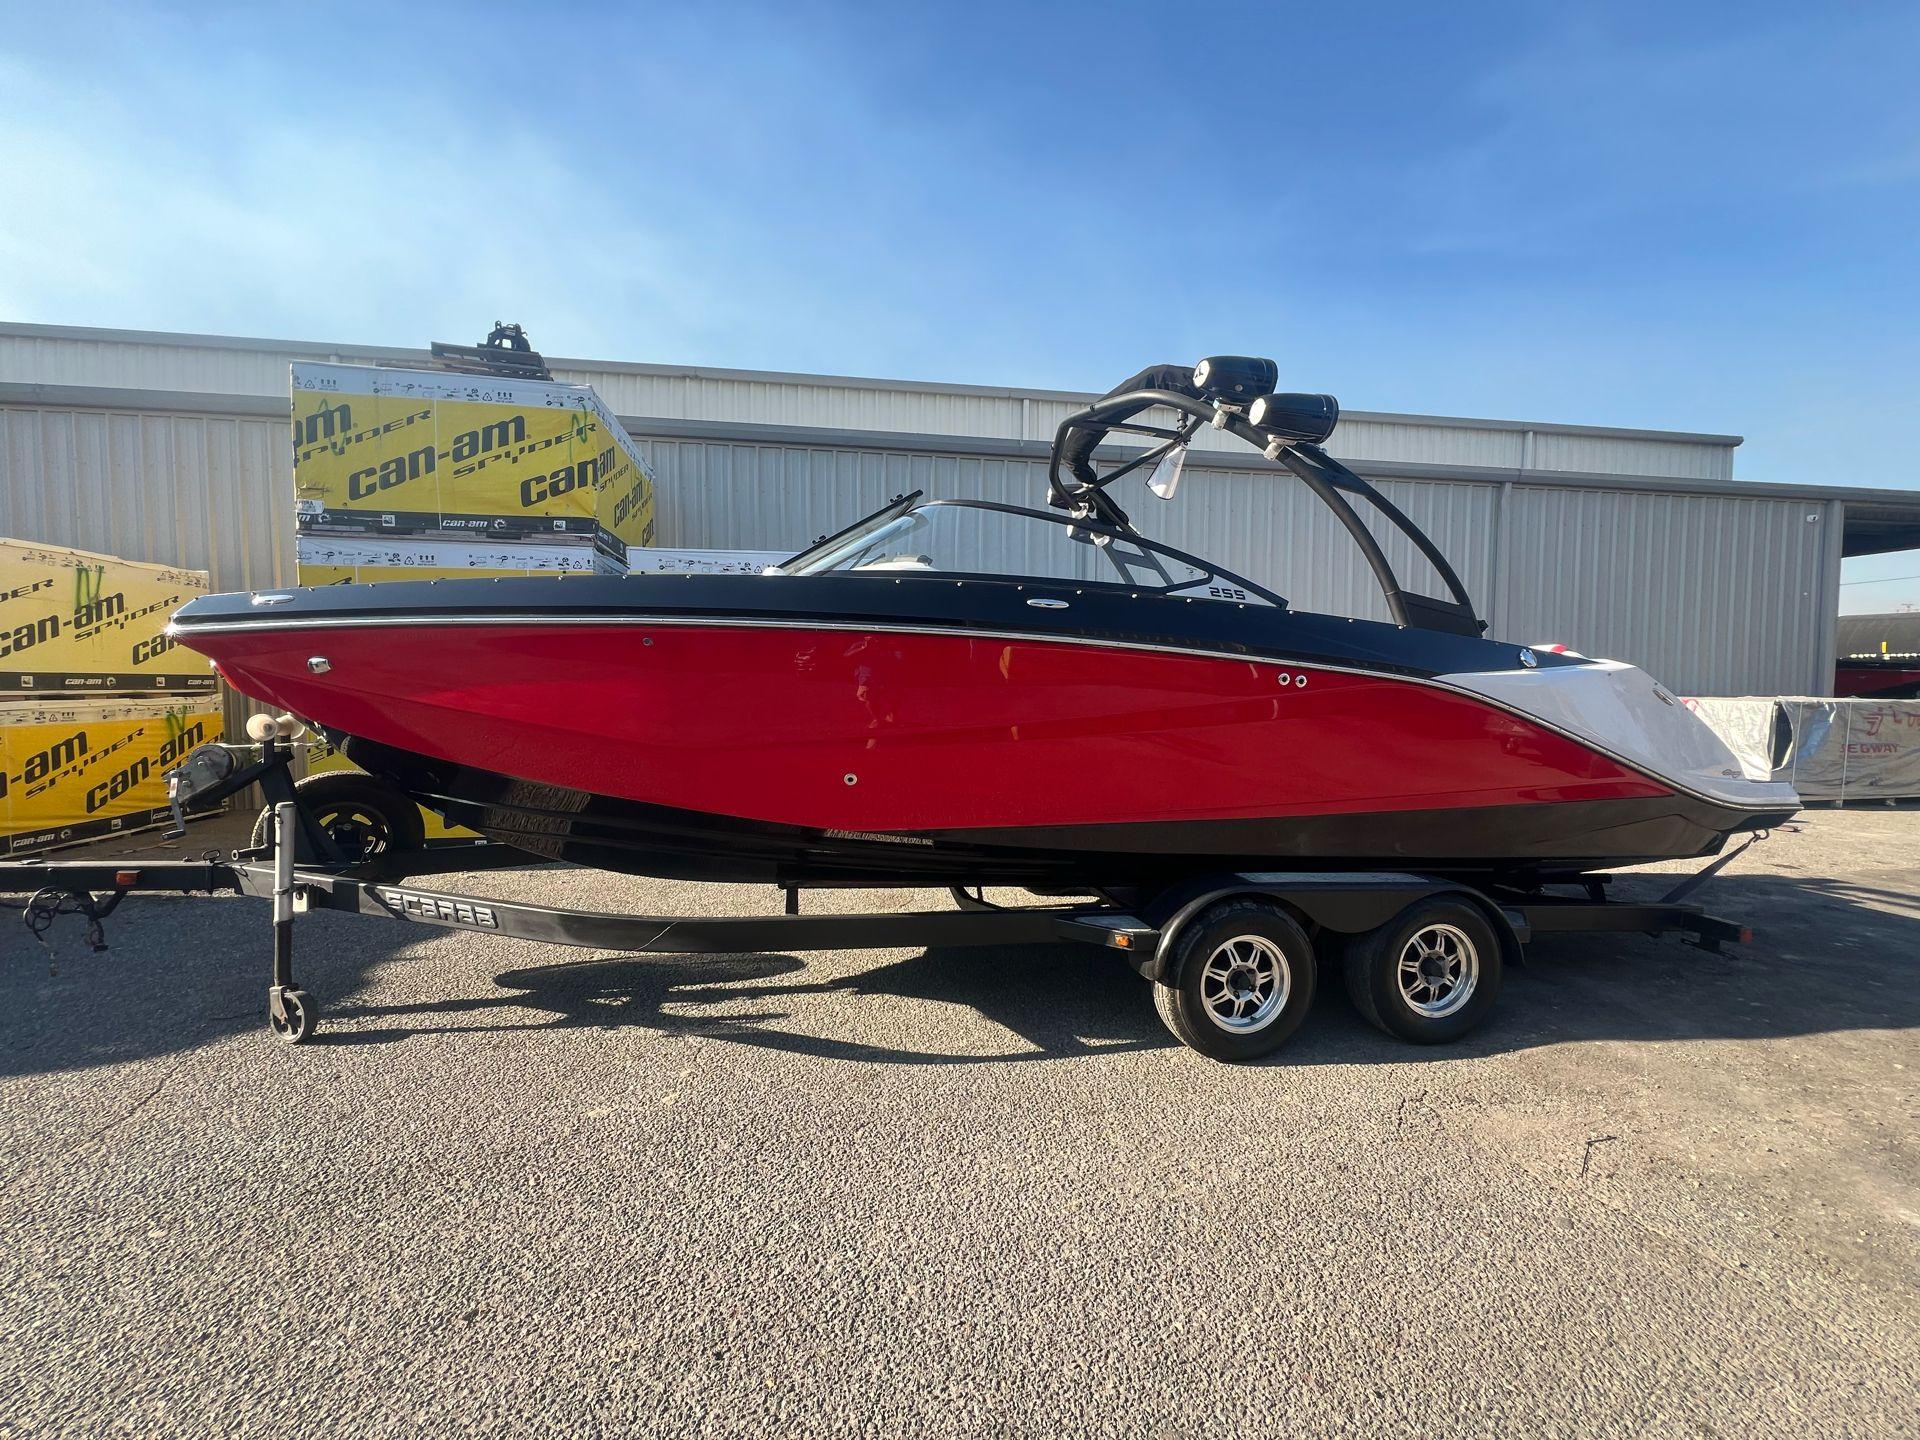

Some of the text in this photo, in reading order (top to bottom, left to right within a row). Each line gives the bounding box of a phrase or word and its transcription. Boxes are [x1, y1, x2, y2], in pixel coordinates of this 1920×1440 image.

[348, 415, 526, 501] can-am
[453, 423, 596, 479] SPYDER
[442, 518, 488, 528] can-am
[614, 479, 643, 529] can-am
[75, 595, 180, 642] SPYDER
[1208, 586, 1246, 601] 255
[0, 592, 125, 658] can-am
[25, 727, 145, 799] SPYDER
[86, 721, 204, 814] can-am
[13, 833, 56, 848] can-am
[385, 891, 497, 930] SCARAB
